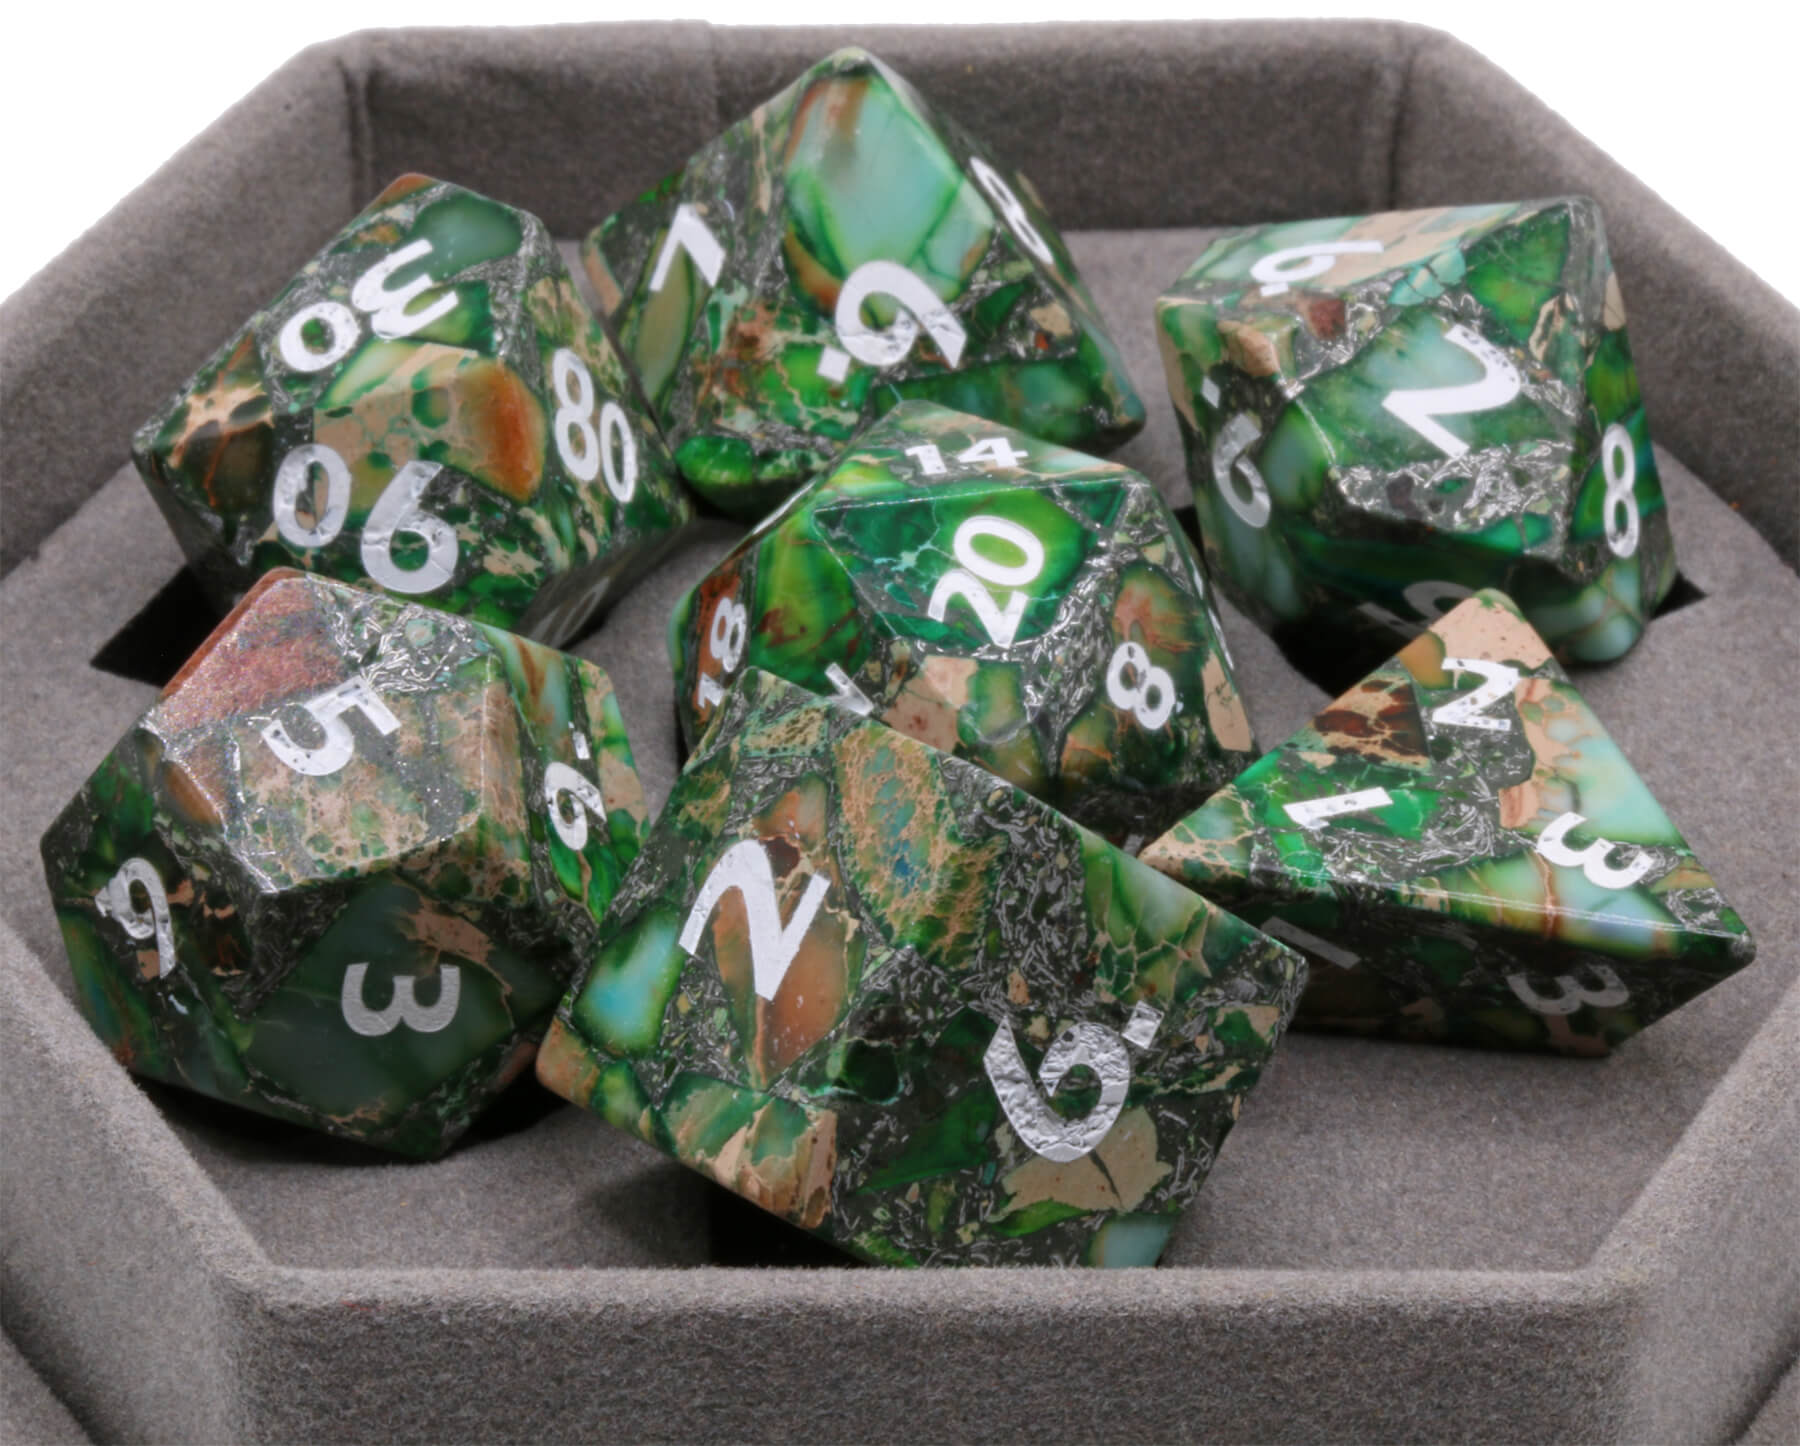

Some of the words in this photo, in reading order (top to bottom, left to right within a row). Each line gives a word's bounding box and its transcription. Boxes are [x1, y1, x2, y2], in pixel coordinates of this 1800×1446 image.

[650, 204, 725, 291] 7
[970, 157, 1053, 264] 8
[280, 239, 459, 372] 30
[552, 349, 636, 502] 80
[1382, 324, 1521, 459] 2
[905, 437, 1028, 475] 14
[1602, 423, 1640, 558] 8
[273, 444, 459, 594] 90
[928, 515, 1044, 650] 20
[261, 674, 401, 776] 5
[1106, 641, 1176, 730] 8
[1432, 657, 1520, 731] 2
[1283, 787, 1393, 830] 1
[1537, 811, 1654, 889] 3
[678, 839, 830, 1000] 2
[341, 962, 460, 1036] 3
[1506, 958, 1631, 1016] 3
